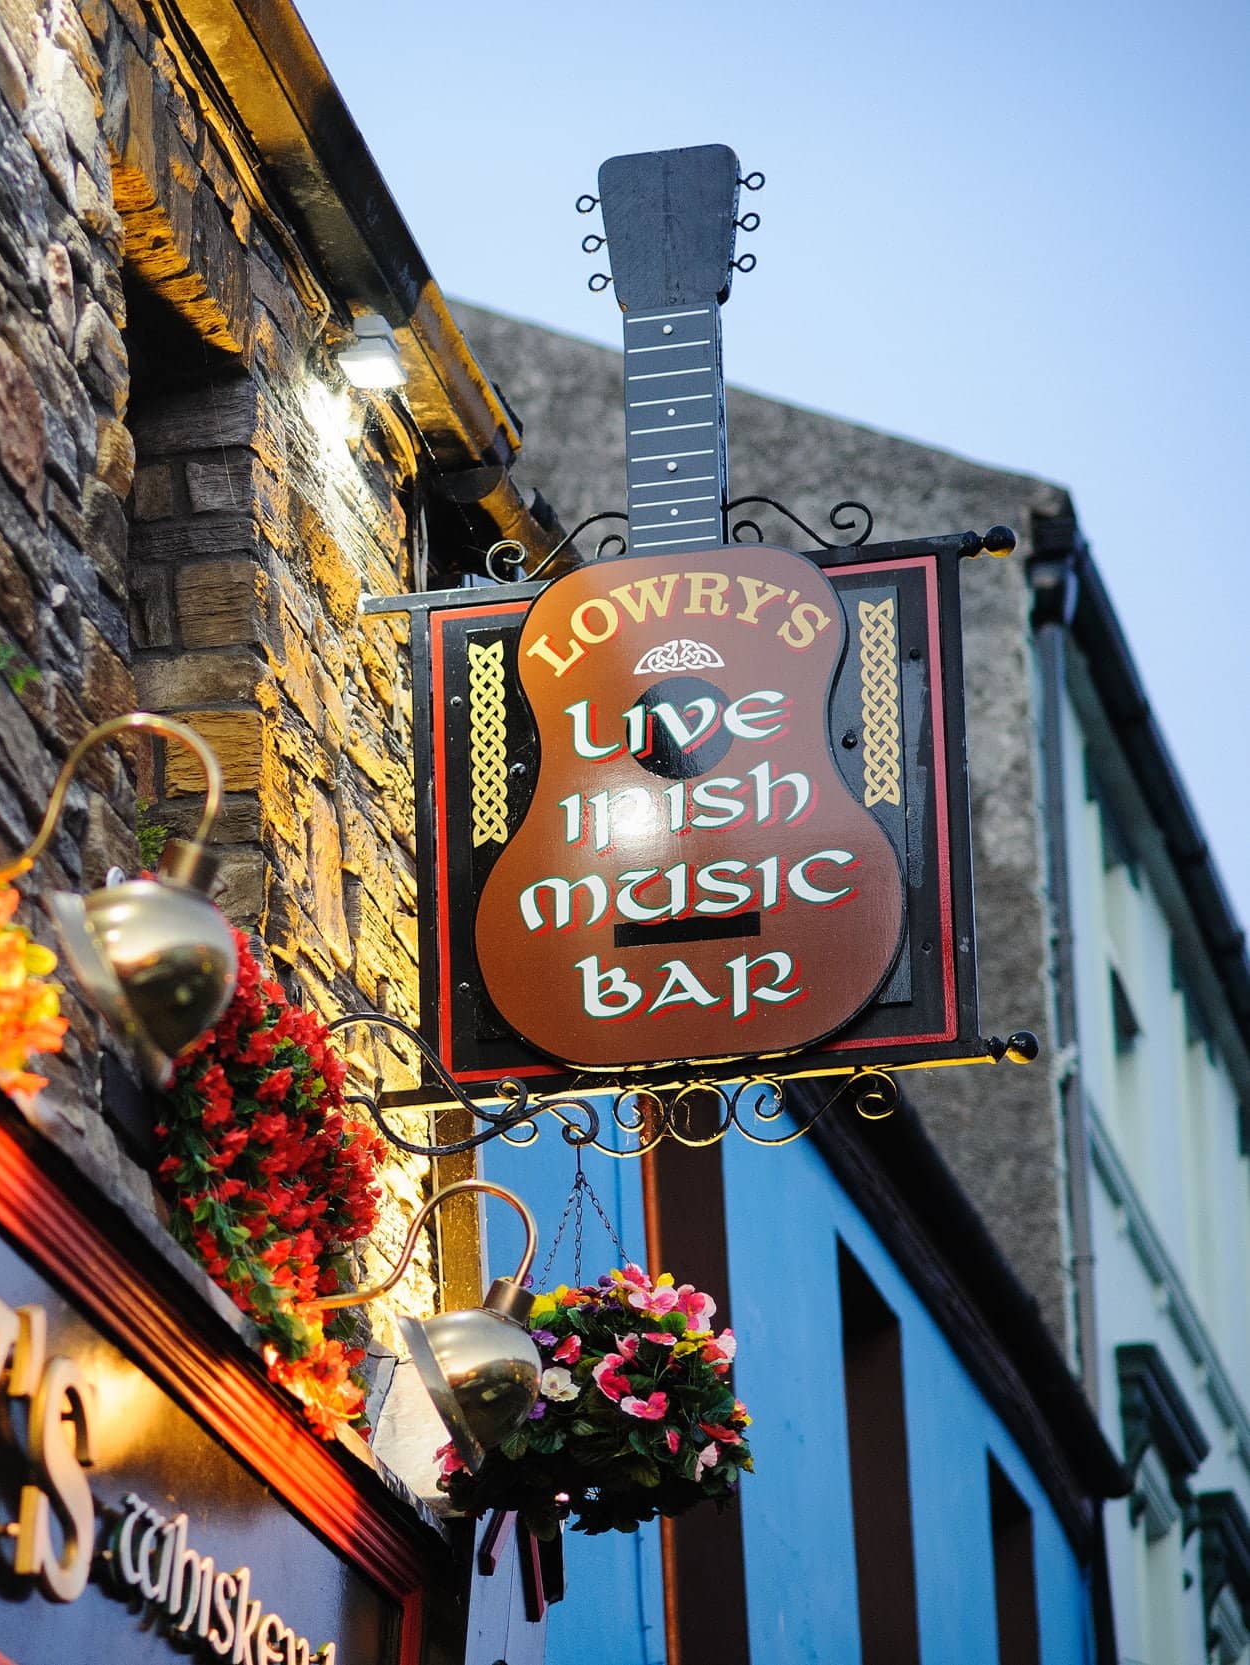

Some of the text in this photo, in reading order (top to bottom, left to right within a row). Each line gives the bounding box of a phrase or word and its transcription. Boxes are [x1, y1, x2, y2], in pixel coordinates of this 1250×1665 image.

[526, 571, 831, 677] LOWRY'S
[565, 690, 788, 759] LIVE
[575, 951, 802, 1019] BAR
